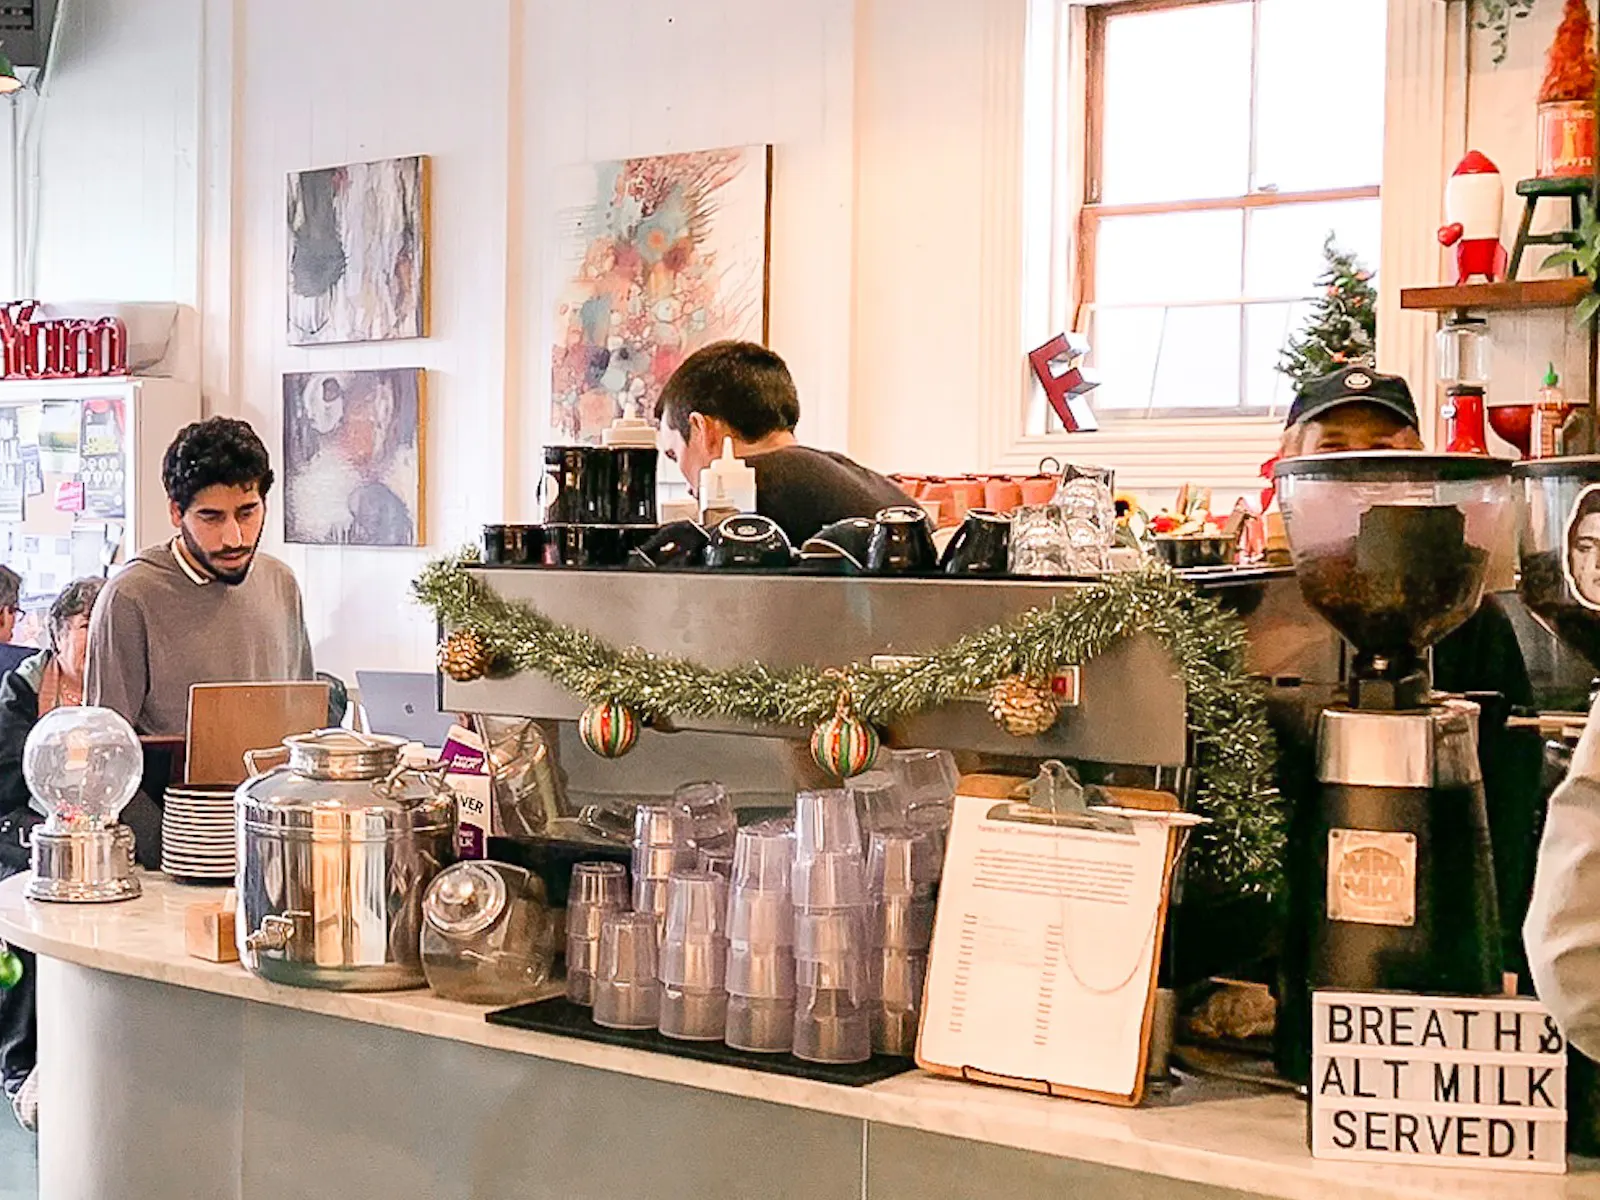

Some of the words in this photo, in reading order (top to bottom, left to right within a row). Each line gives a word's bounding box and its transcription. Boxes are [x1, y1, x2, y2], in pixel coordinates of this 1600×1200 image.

[1028, 332, 1099, 433] F
[1328, 1004, 1521, 1052] BREATH
[1320, 1057, 1409, 1099] ALT
[1433, 1062, 1556, 1108] MILK
[1331, 1109, 1536, 1160] SERVED!
